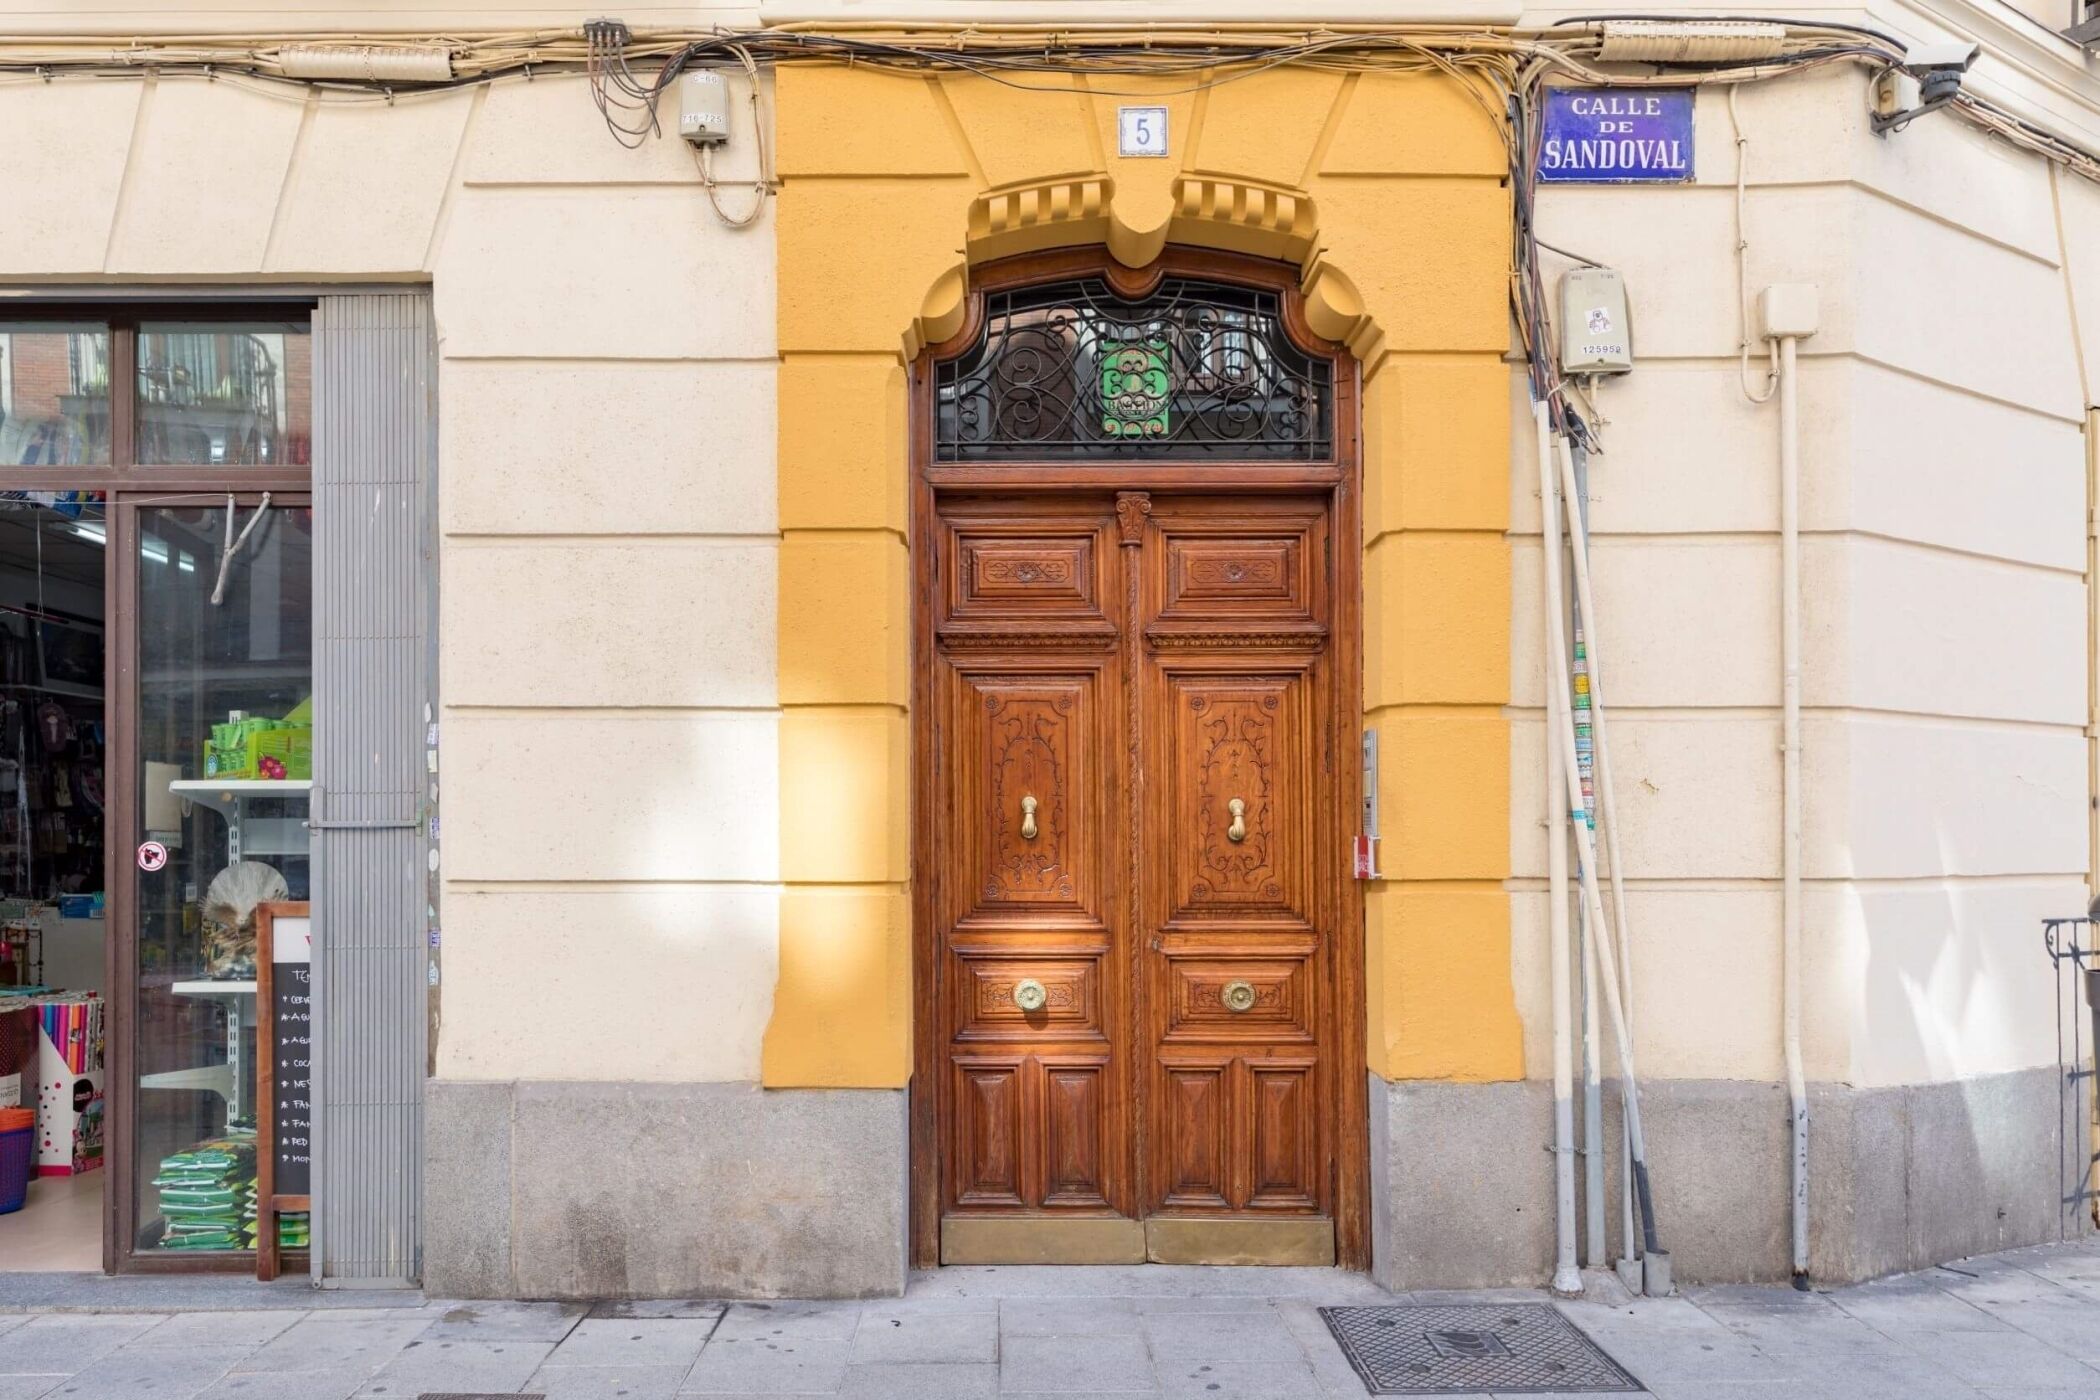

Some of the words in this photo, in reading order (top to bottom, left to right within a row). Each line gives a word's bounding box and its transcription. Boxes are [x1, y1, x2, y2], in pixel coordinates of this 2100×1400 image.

[1571, 97, 1662, 116] CALLE
[1136, 118, 1150, 145] 5
[1599, 121, 1634, 133] DE
[1544, 139, 1686, 169] SANDOVAL
